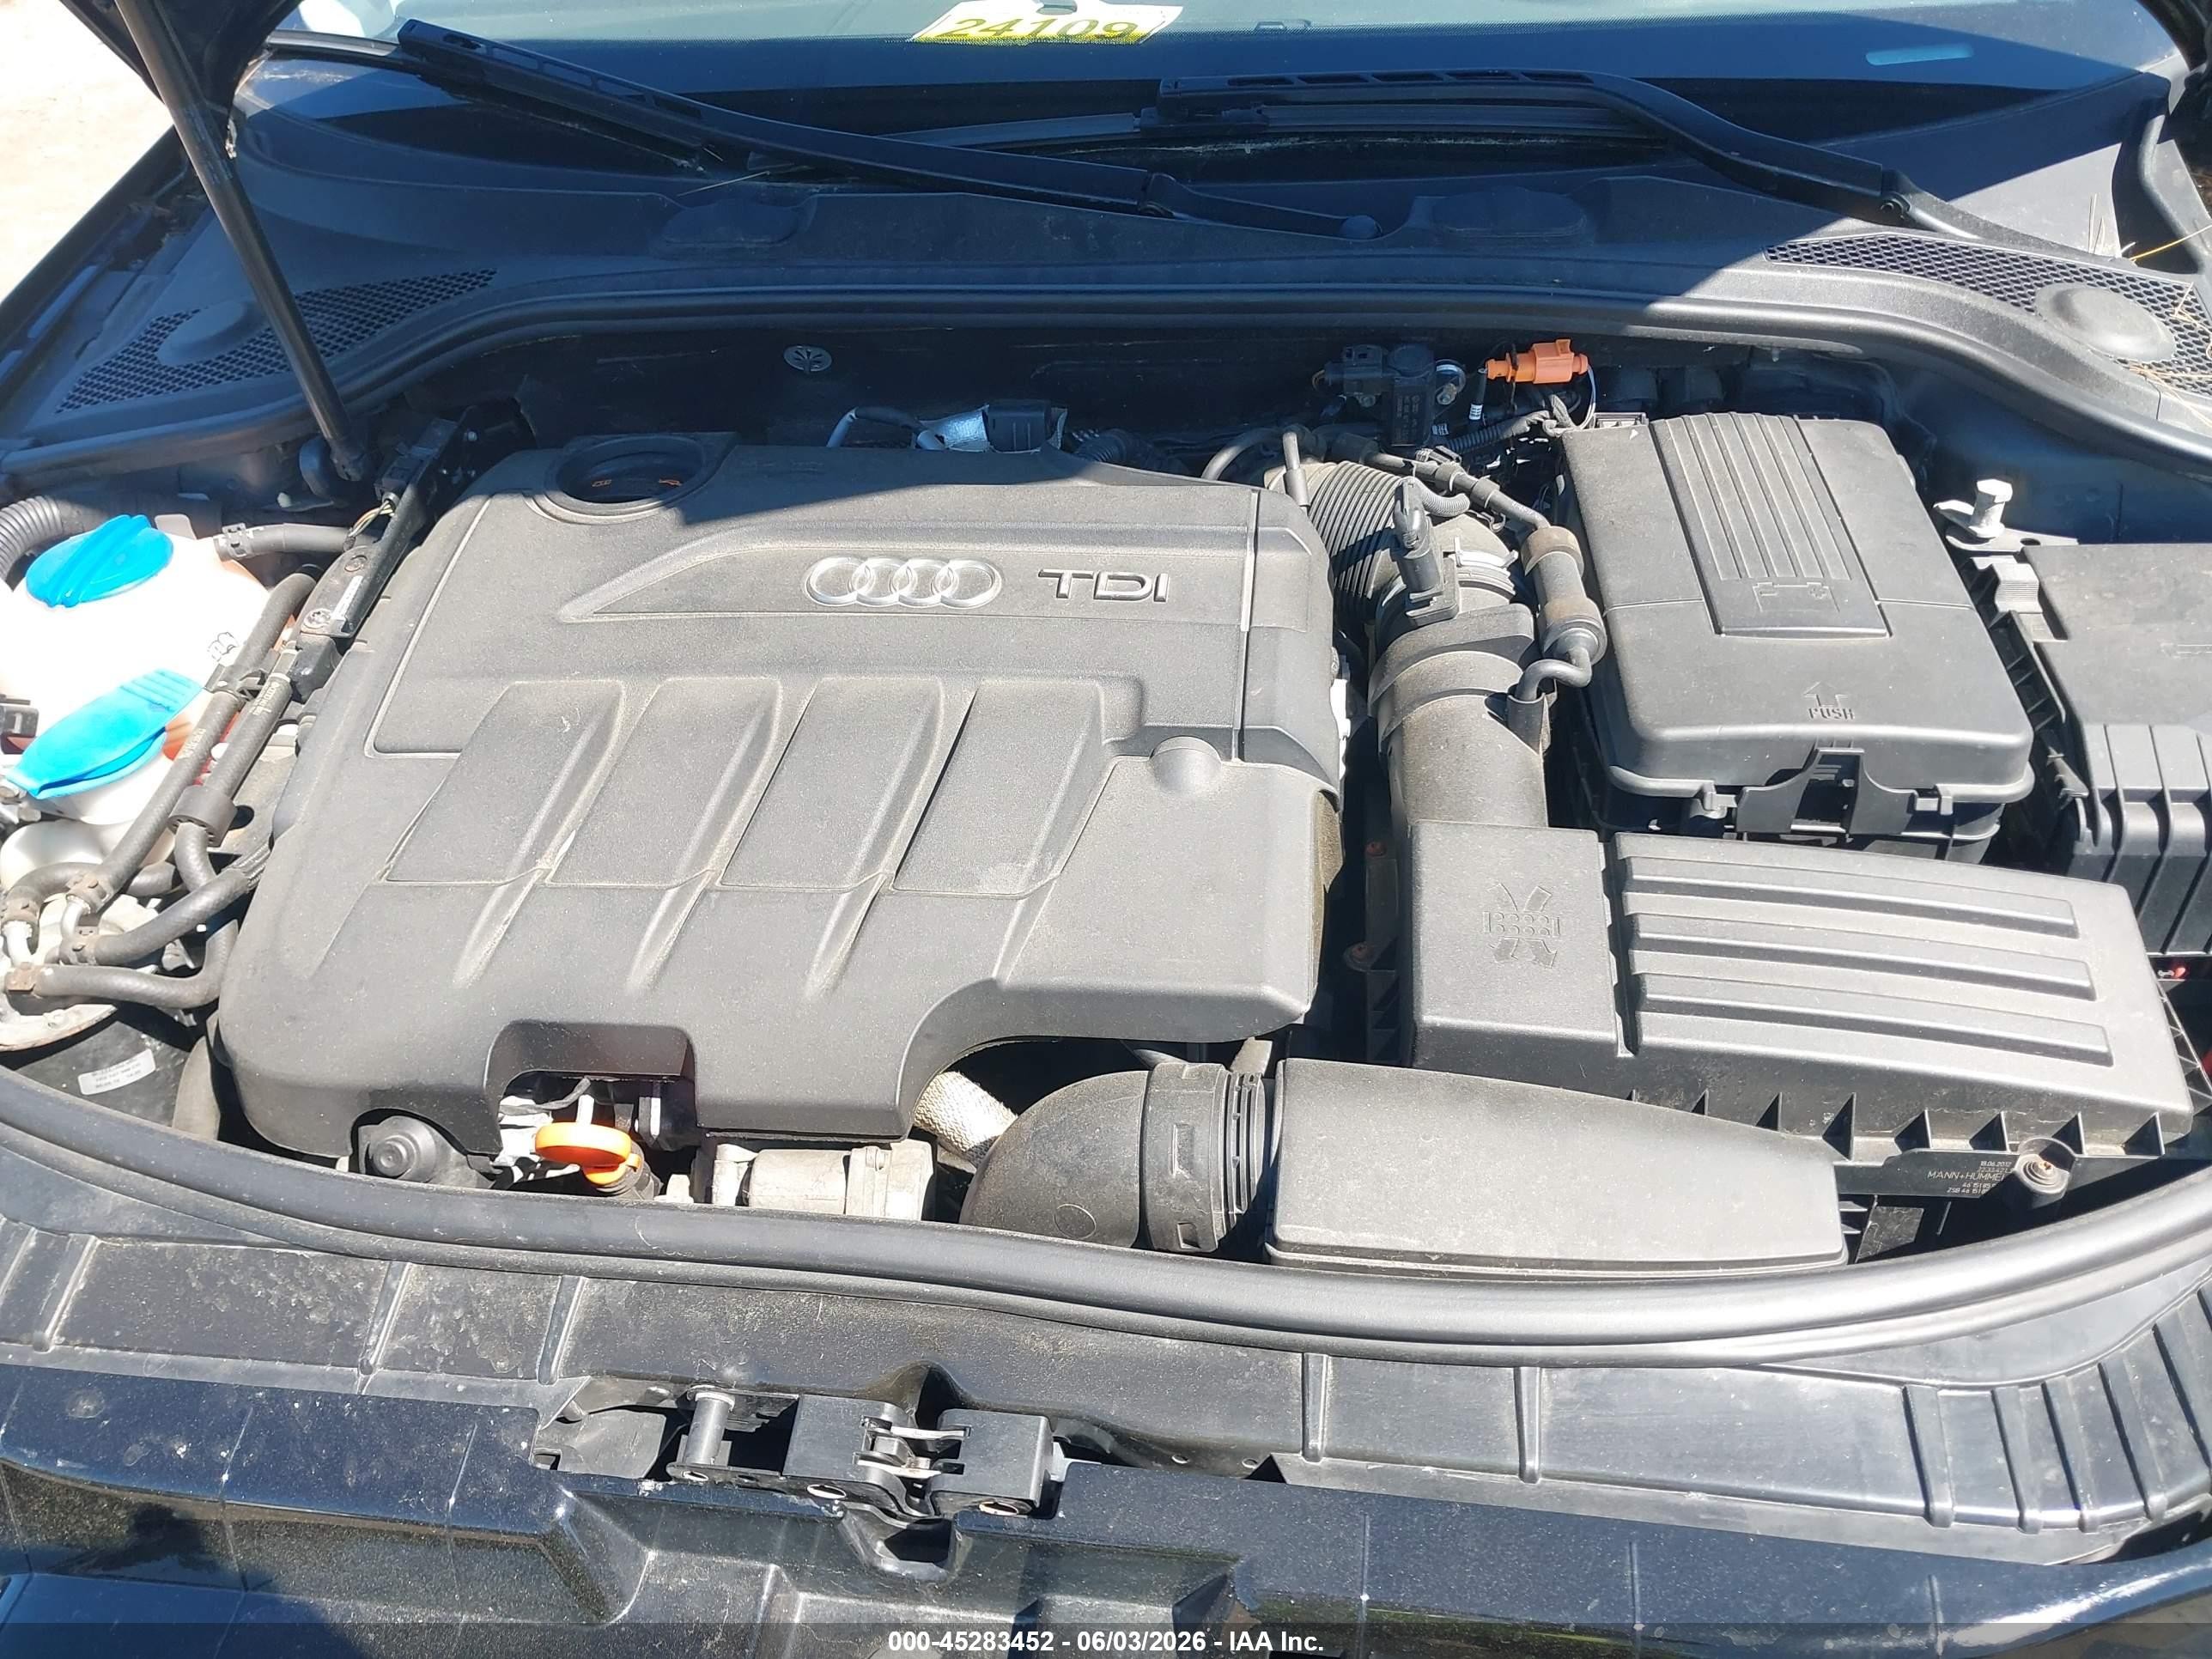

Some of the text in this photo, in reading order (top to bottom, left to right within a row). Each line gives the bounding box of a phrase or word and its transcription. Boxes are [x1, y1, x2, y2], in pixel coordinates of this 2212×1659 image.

[937, 18, 1139, 40] 24109
[1038, 568, 1169, 602] TDI
[1808, 708, 1855, 720] PUSH
